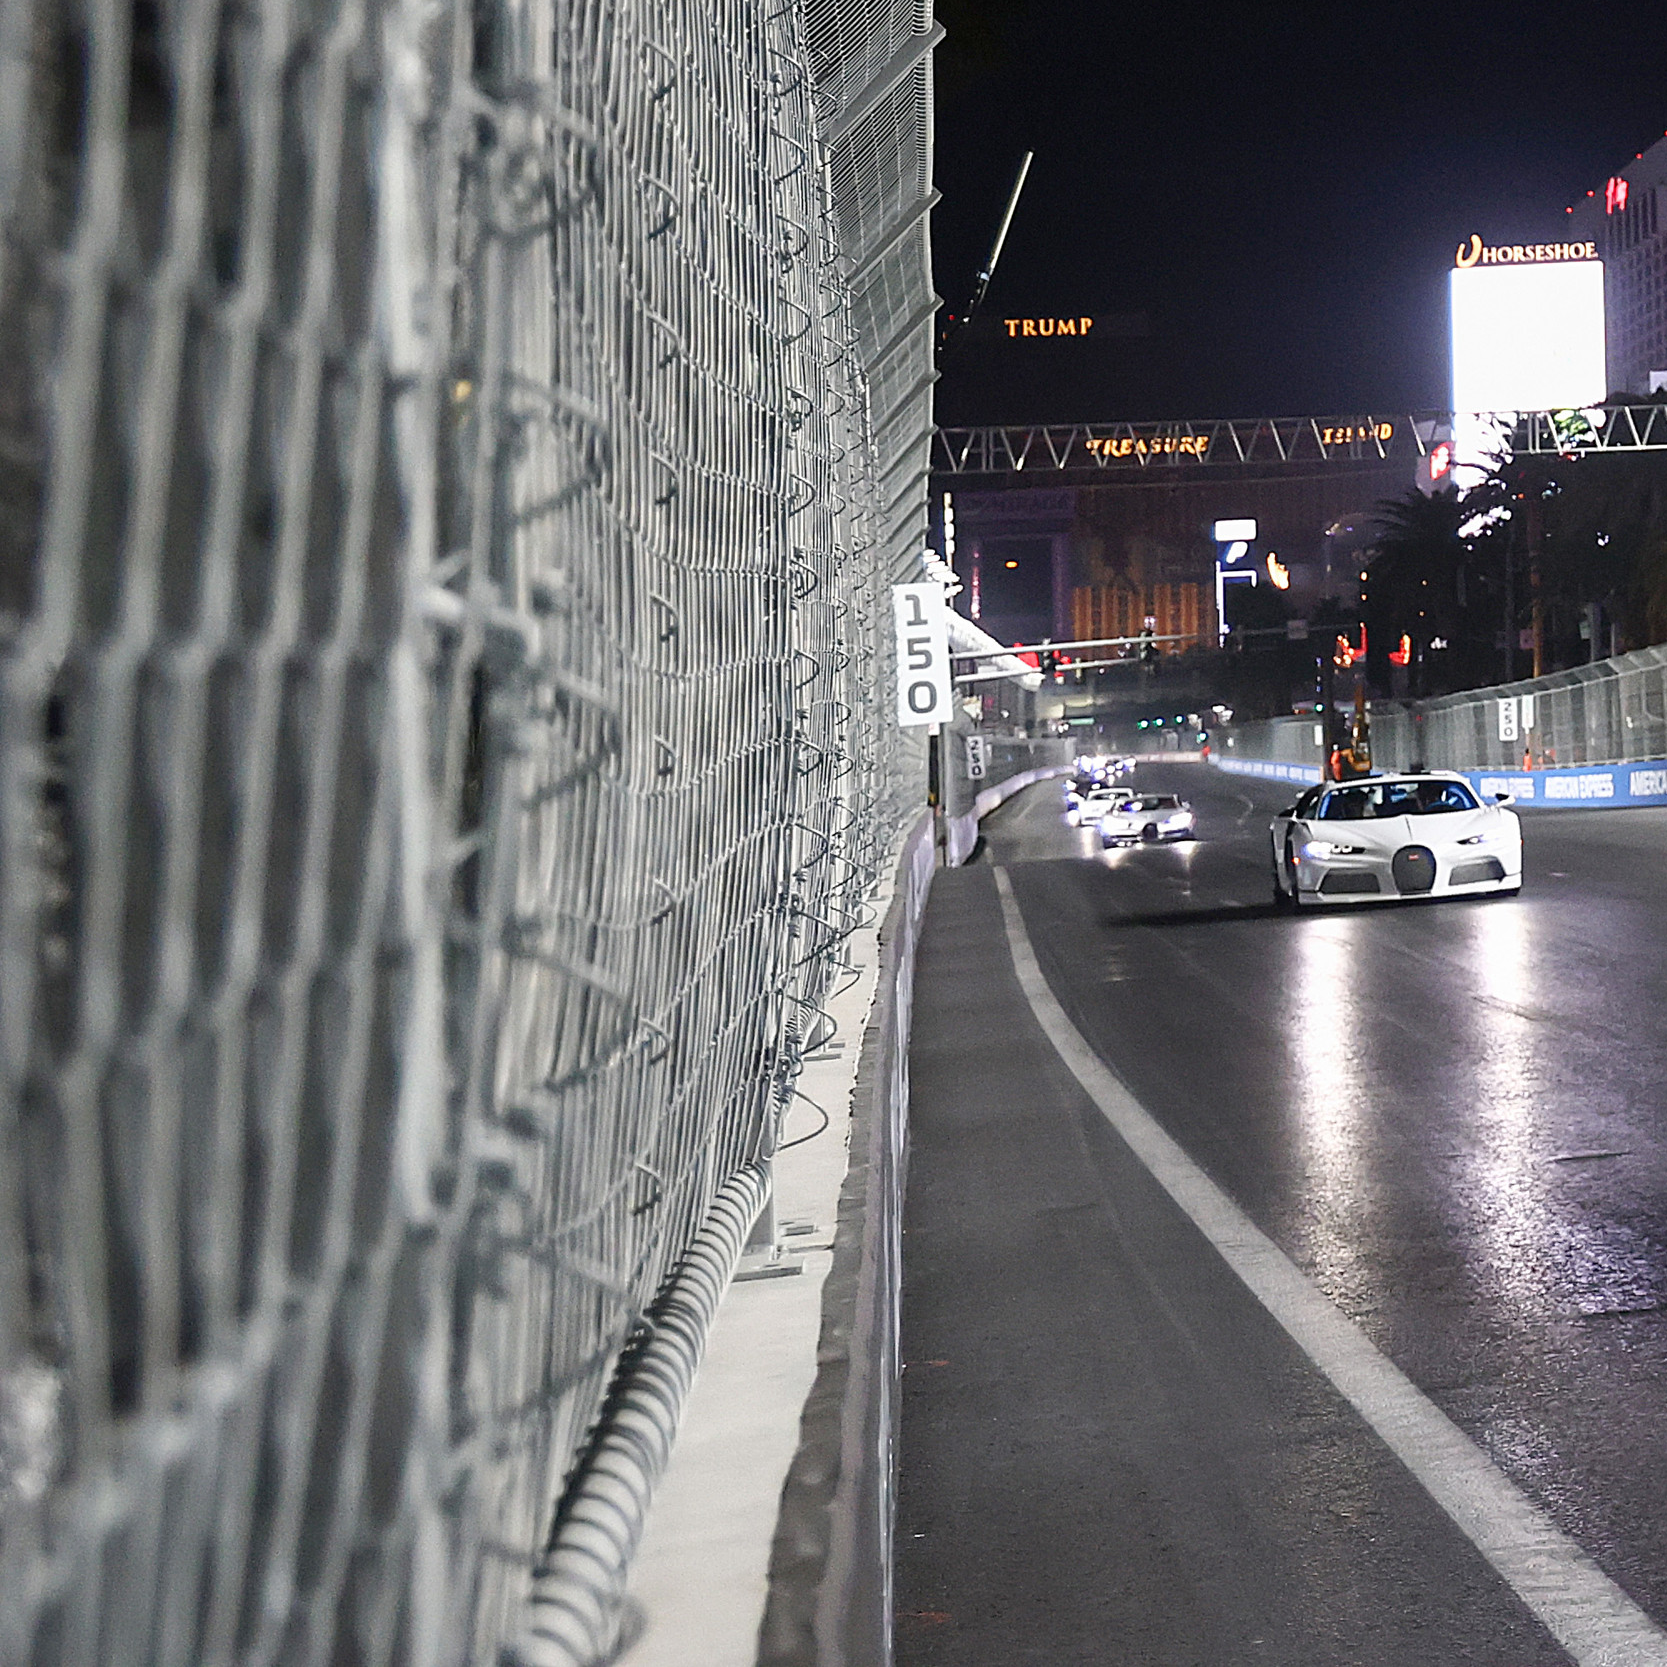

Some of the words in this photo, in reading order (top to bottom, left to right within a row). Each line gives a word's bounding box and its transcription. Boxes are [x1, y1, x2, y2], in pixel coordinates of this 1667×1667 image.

[1482, 241, 1596, 264] HORSESHOE
[1003, 317, 1093, 337] TRUMP
[1086, 436, 1210, 458] TREASURE
[904, 593, 938, 714] 150
[1503, 701, 1514, 737] 250
